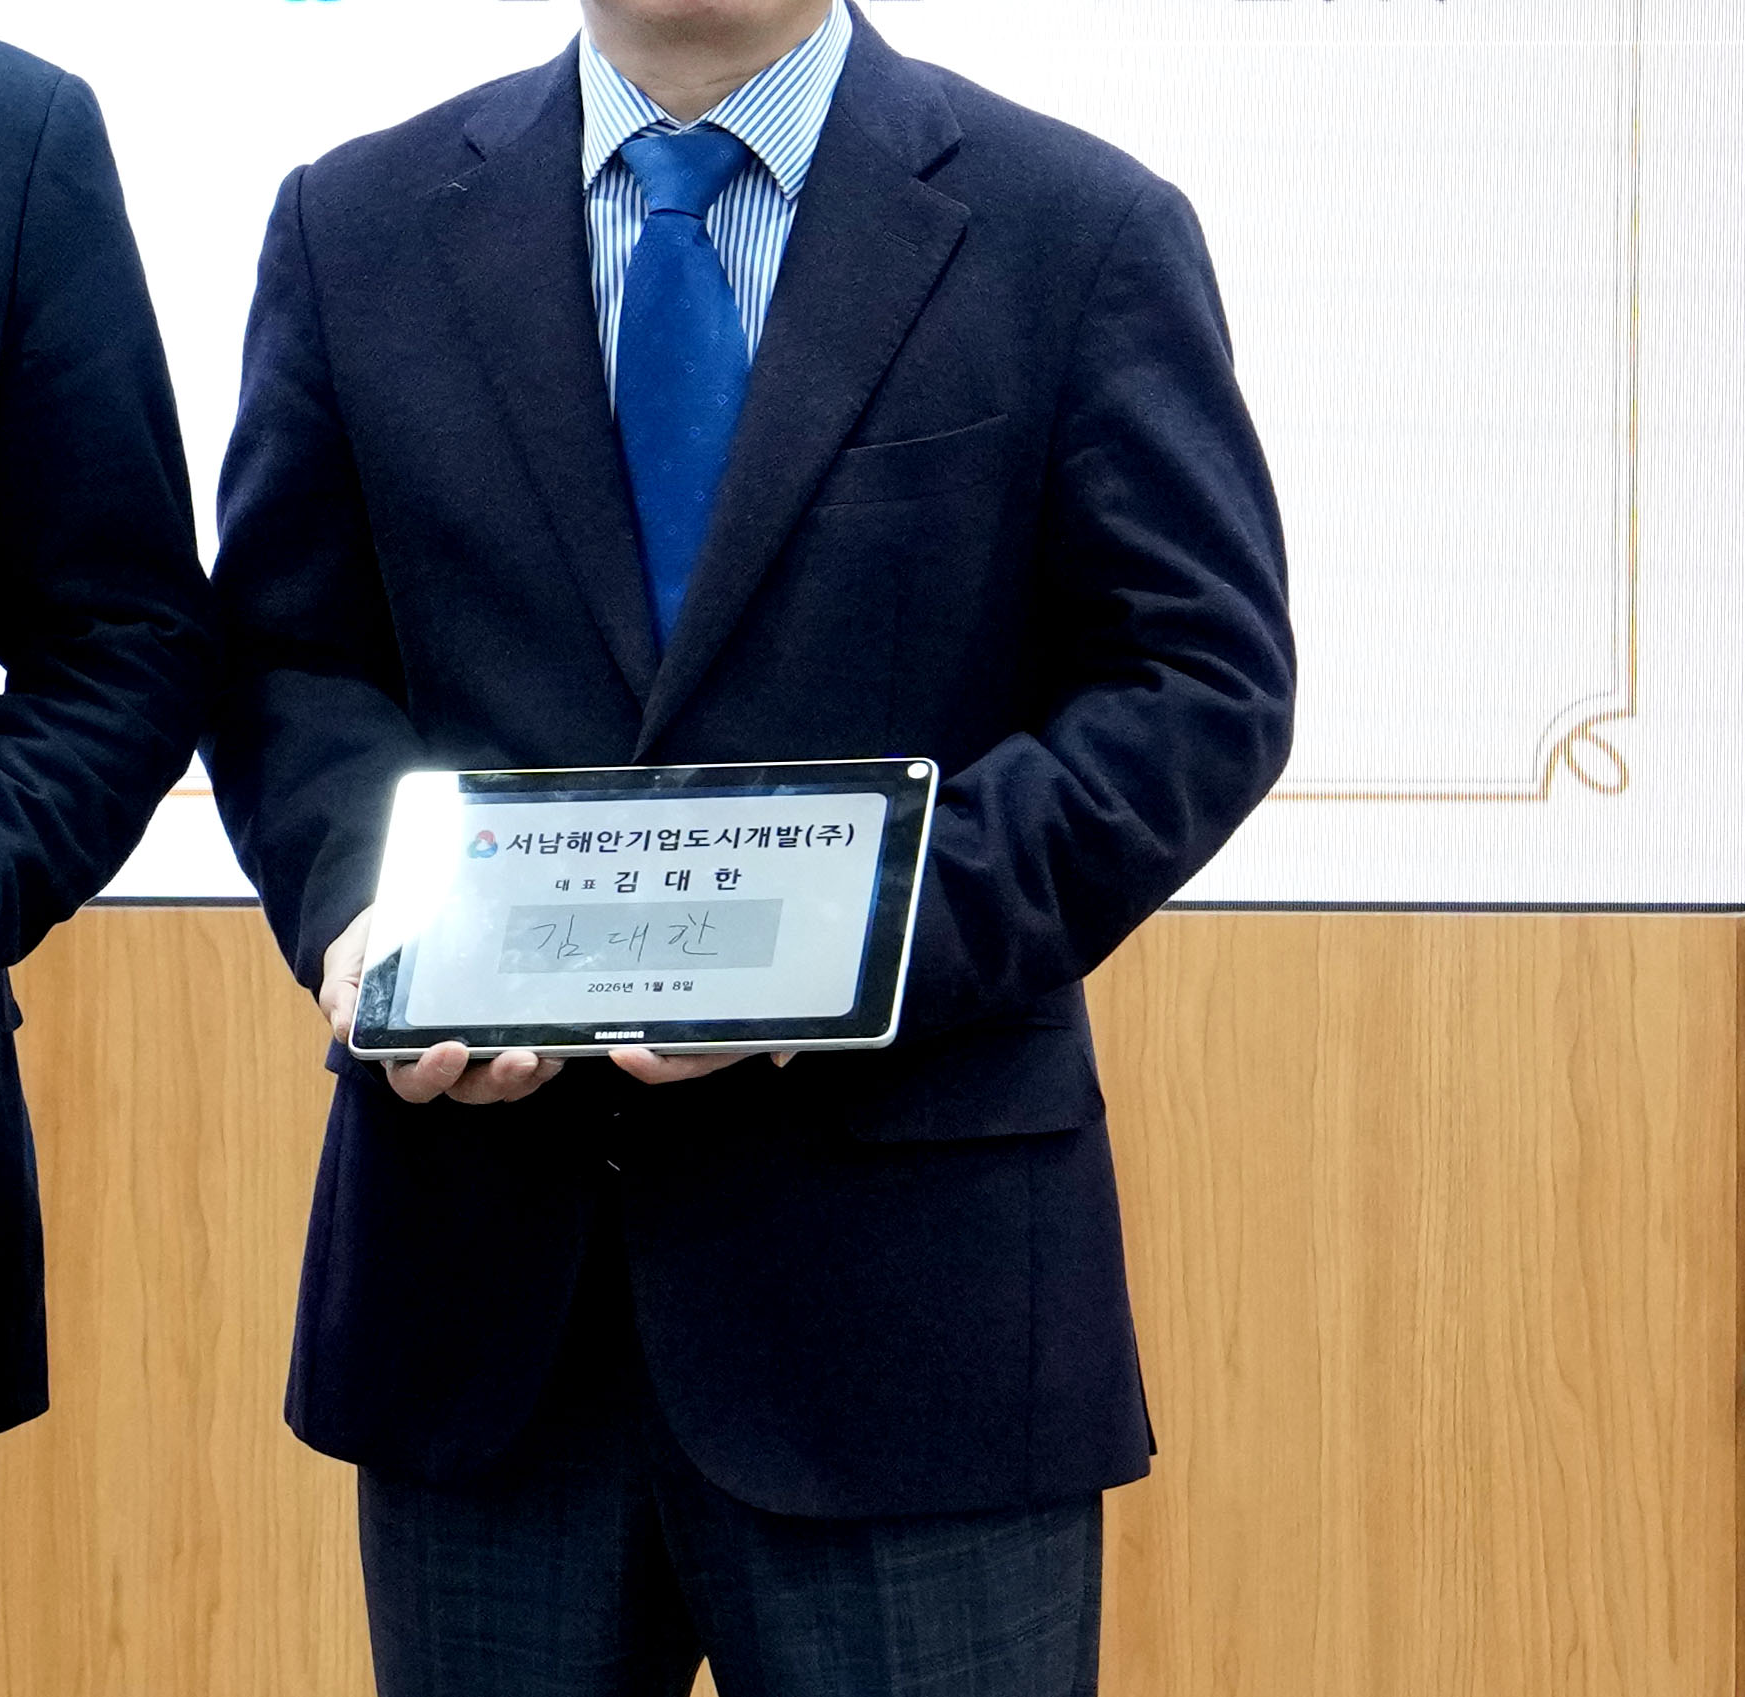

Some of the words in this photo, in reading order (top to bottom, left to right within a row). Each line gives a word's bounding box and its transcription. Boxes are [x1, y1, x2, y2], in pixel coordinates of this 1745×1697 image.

[506, 823, 855, 855] 서남해안기업도시개발(주)
[587, 982, 634, 993] 2026년
[644, 981, 664, 993] 1월
[672, 980, 694, 992] 8일
[594, 1030, 645, 1040] SAMSUNG
